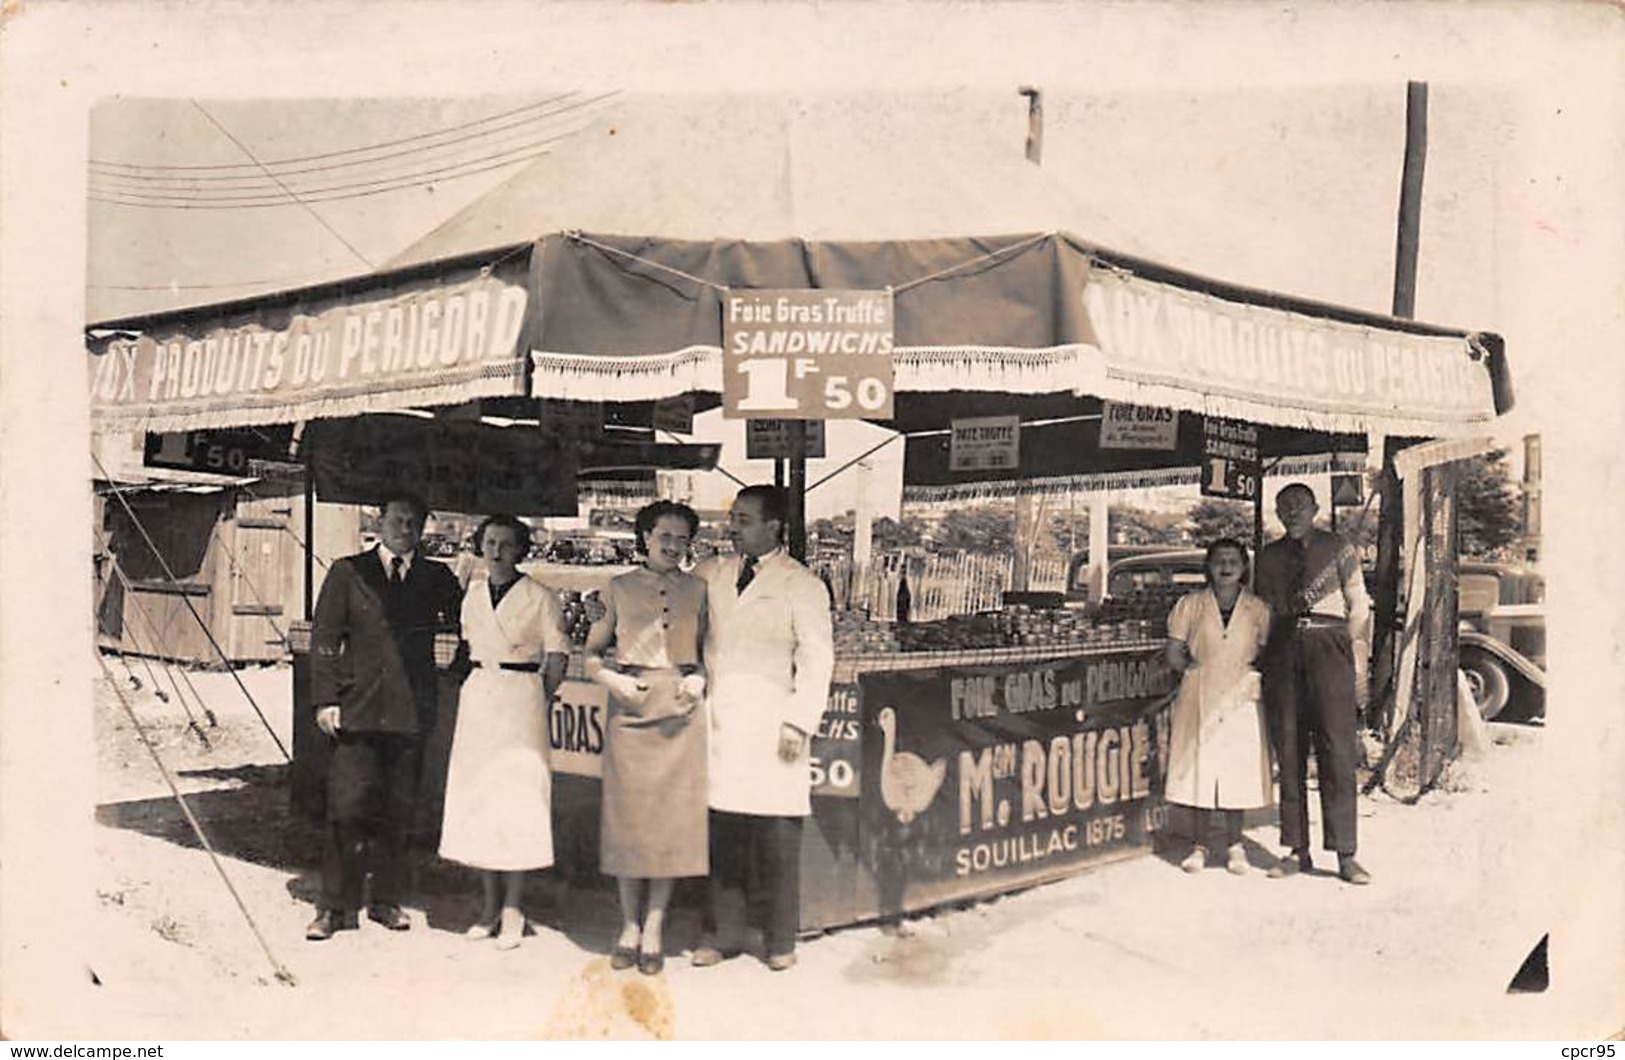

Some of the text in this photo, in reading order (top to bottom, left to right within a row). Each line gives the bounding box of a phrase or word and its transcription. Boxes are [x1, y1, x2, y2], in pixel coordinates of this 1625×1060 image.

[729, 297, 772, 323] Foie
[776, 297, 823, 323] Gras
[149, 332, 288, 401] PRODUITS
[296, 331, 331, 383] DU
[339, 285, 528, 378] PERIGORD
[732, 331, 894, 355] SANDWICHS
[824, 376, 887, 411] 50
[207, 446, 244, 471] 50
[955, 825, 1078, 876] SOUILLAC
[1086, 814, 1126, 846] 1875
